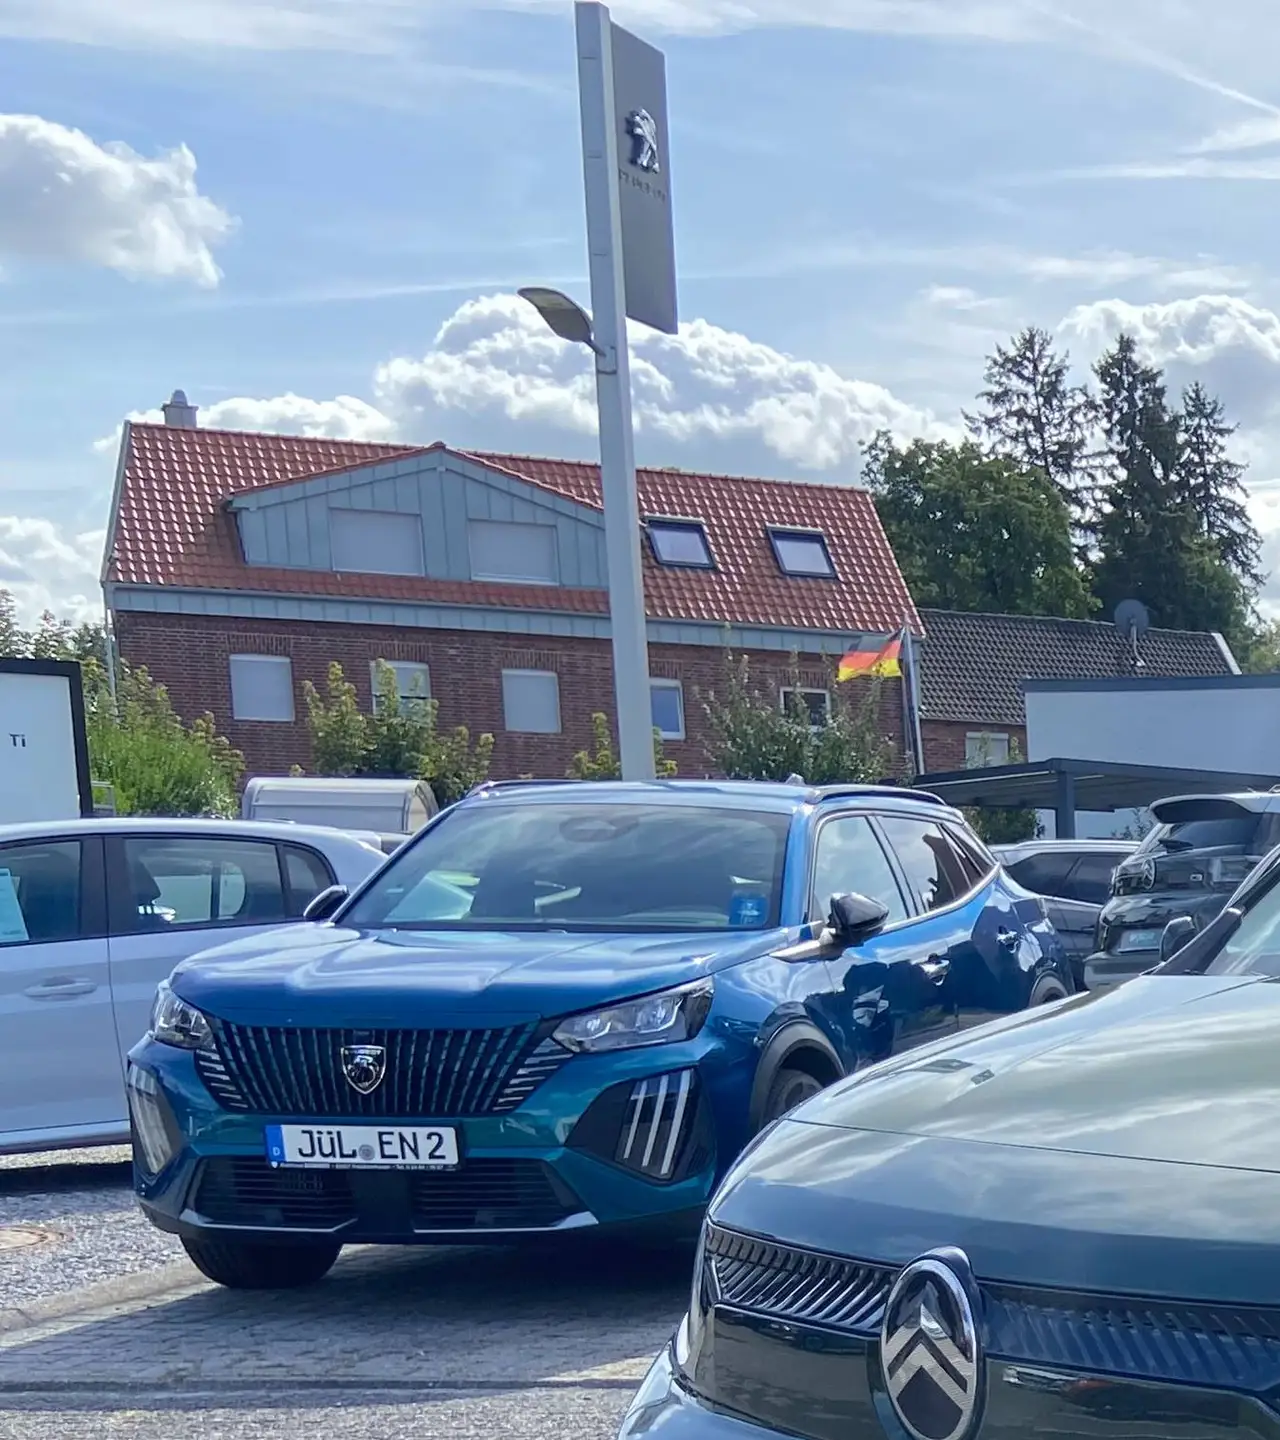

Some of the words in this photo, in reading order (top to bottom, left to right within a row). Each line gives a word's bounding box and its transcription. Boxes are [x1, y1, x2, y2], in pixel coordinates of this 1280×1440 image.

[9, 732, 26, 748] Ti
[298, 1129, 357, 1159] JÜL
[378, 1131, 420, 1160] EN
[426, 1131, 447, 1160] 2
